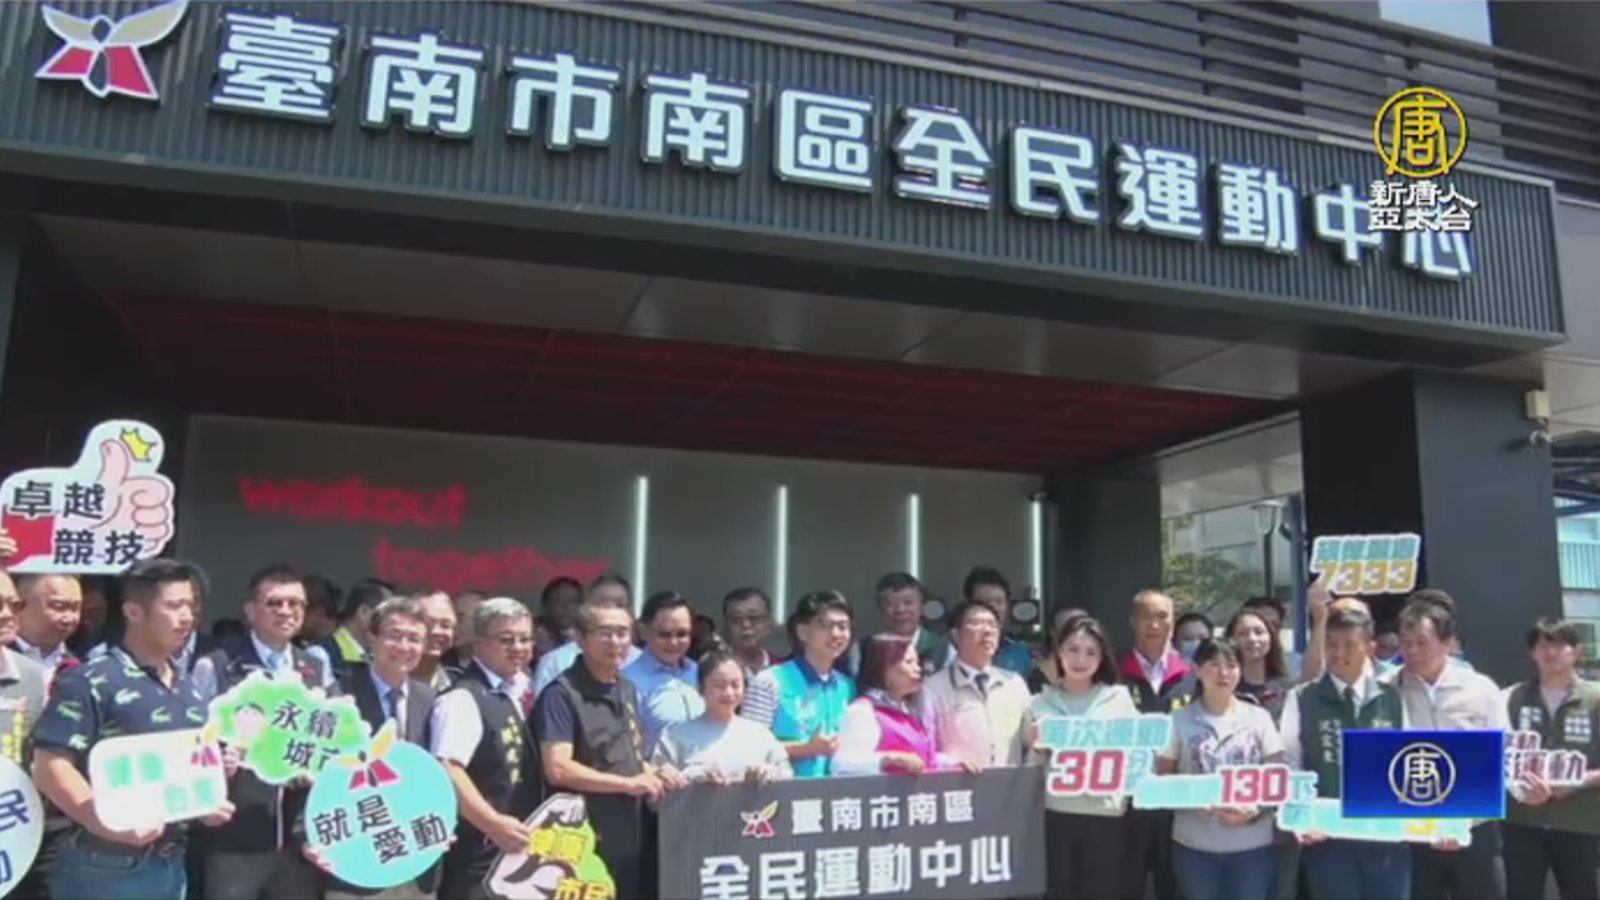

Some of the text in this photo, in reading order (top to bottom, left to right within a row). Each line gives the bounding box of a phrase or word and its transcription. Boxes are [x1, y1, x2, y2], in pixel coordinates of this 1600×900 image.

[208, 13, 1476, 280] 臺南市南區全民運動中心
[10, 480, 105, 519] 卓越
[53, 530, 144, 565] 競技
[313, 794, 393, 847] 就是
[791, 790, 974, 835] 臺南市南區
[373, 813, 448, 864] 愛動
[701, 836, 1011, 900] 全民運動中心
